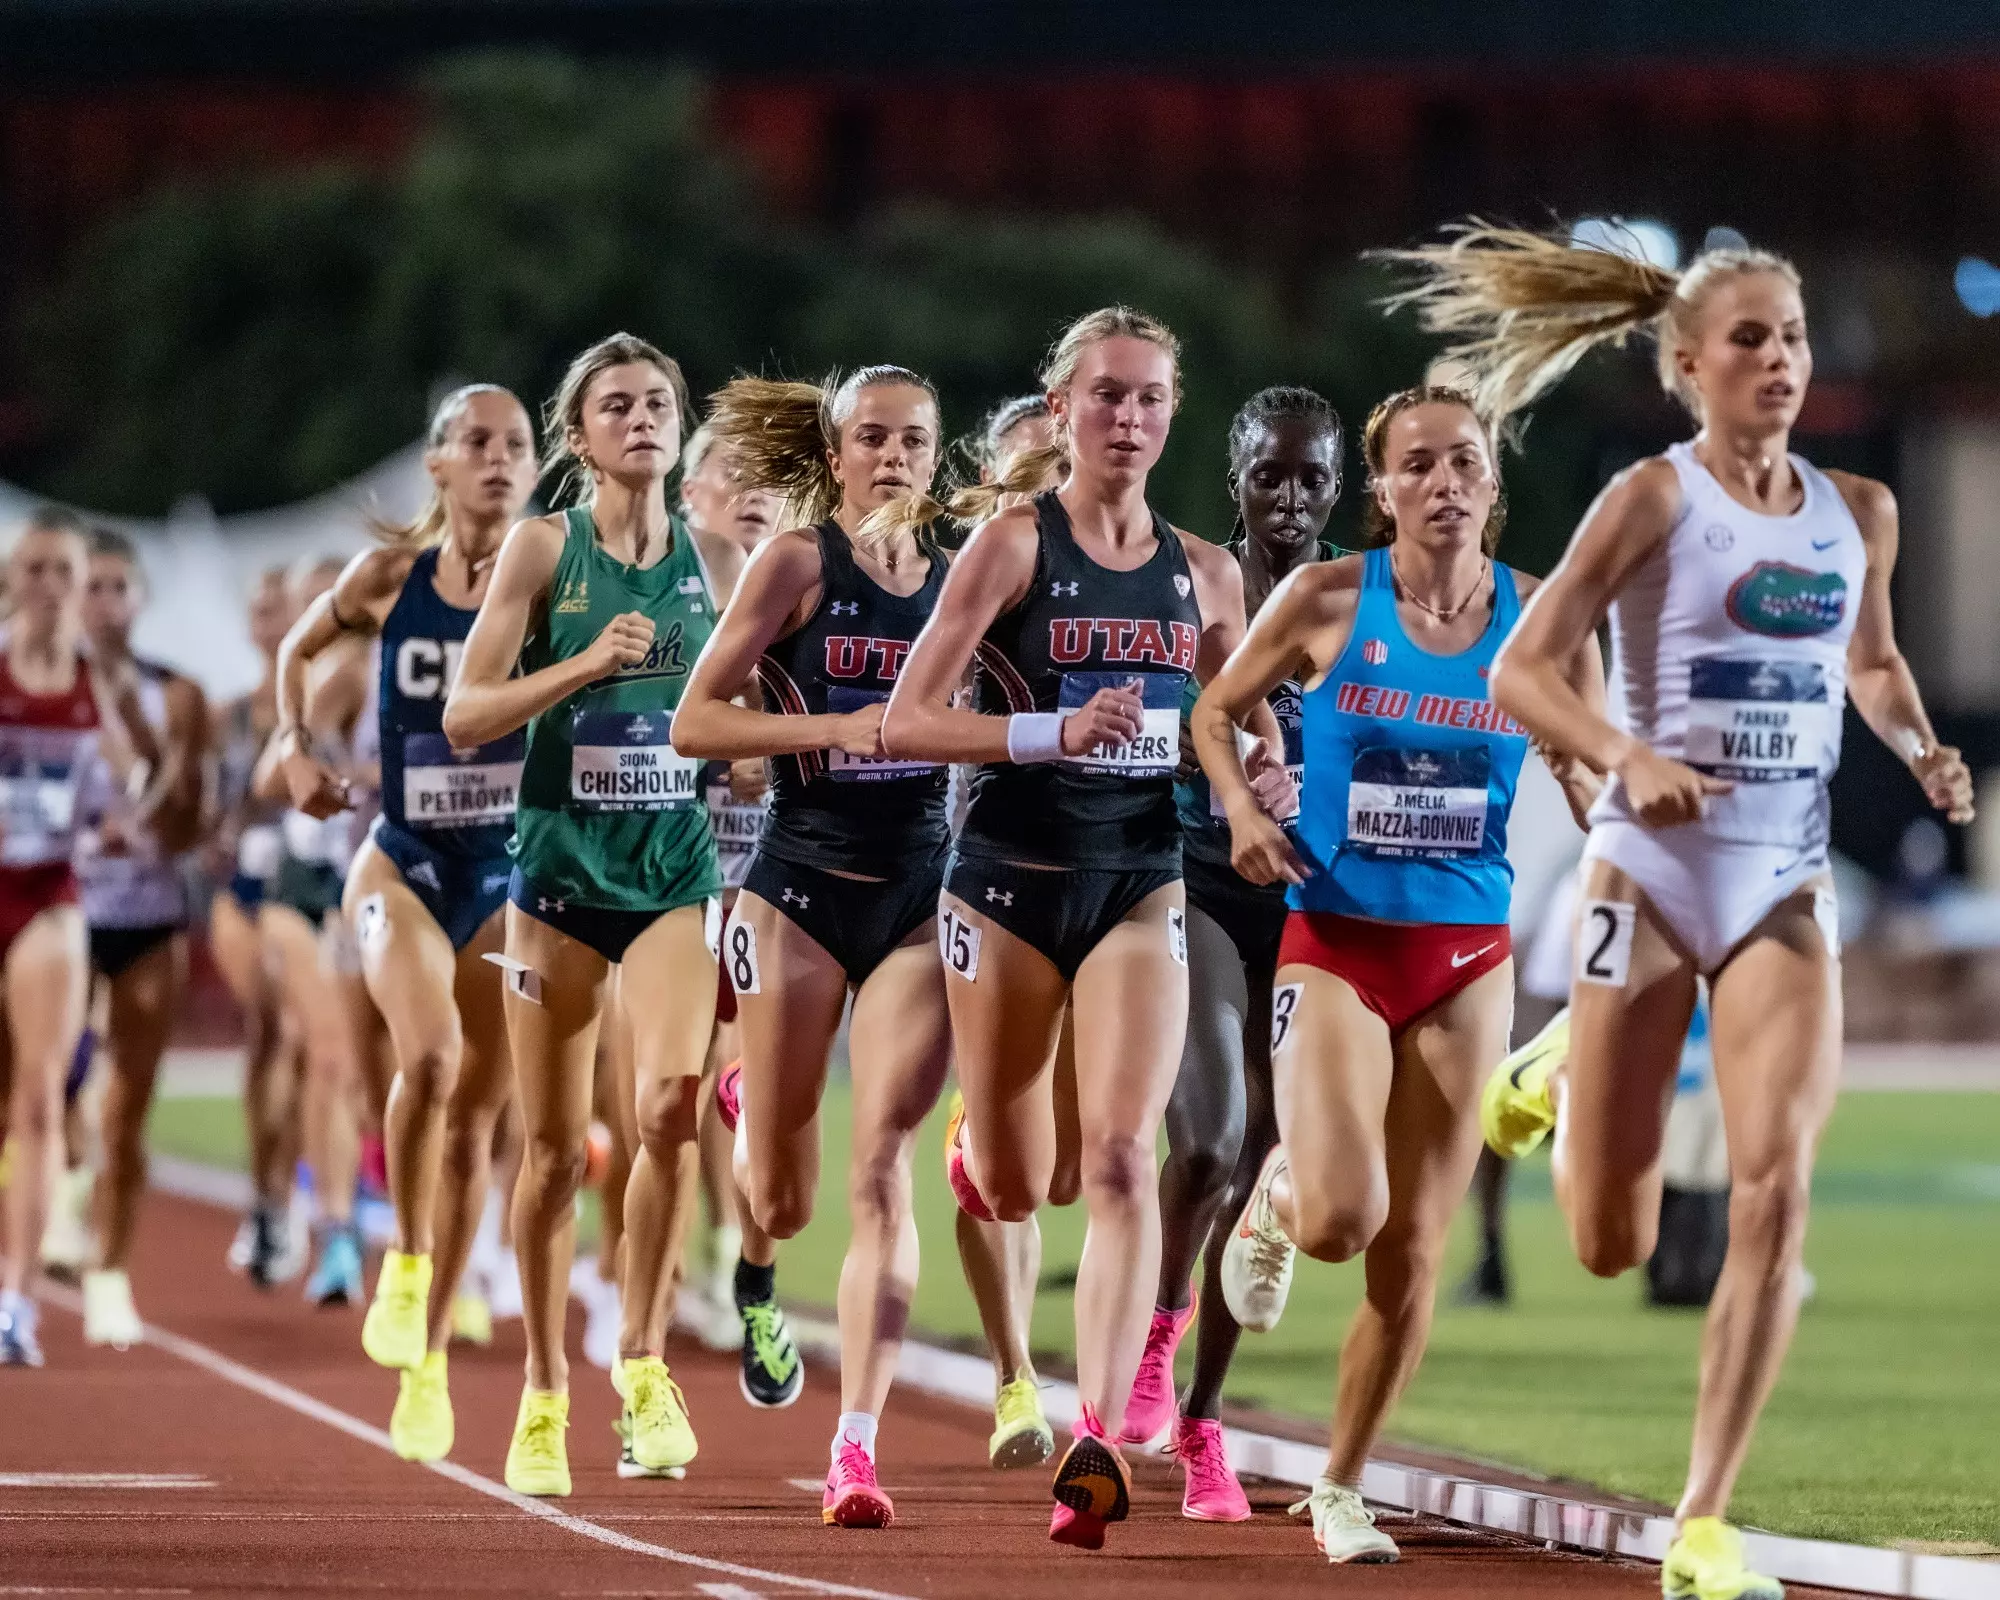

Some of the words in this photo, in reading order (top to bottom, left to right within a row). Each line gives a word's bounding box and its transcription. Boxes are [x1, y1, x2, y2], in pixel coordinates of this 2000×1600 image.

[558, 600, 588, 612] ACC
[825, 636, 912, 680] UT
[1050, 618, 1197, 672] UTAH
[1336, 681, 1412, 720] NEW
[620, 753, 657, 767] SIONA
[1721, 730, 1797, 759] VALBY
[581, 769, 692, 795] CHISHOLM
[883, 772, 892, 780] TX
[420, 786, 514, 813] PETROVA
[1394, 794, 1447, 810] AMELIA
[1356, 810, 1481, 842] MAZZA-DOWNIE
[943, 911, 971, 972] 15
[1586, 906, 1618, 978] 2
[732, 925, 753, 991] 8
[1273, 988, 1297, 1051] 3
